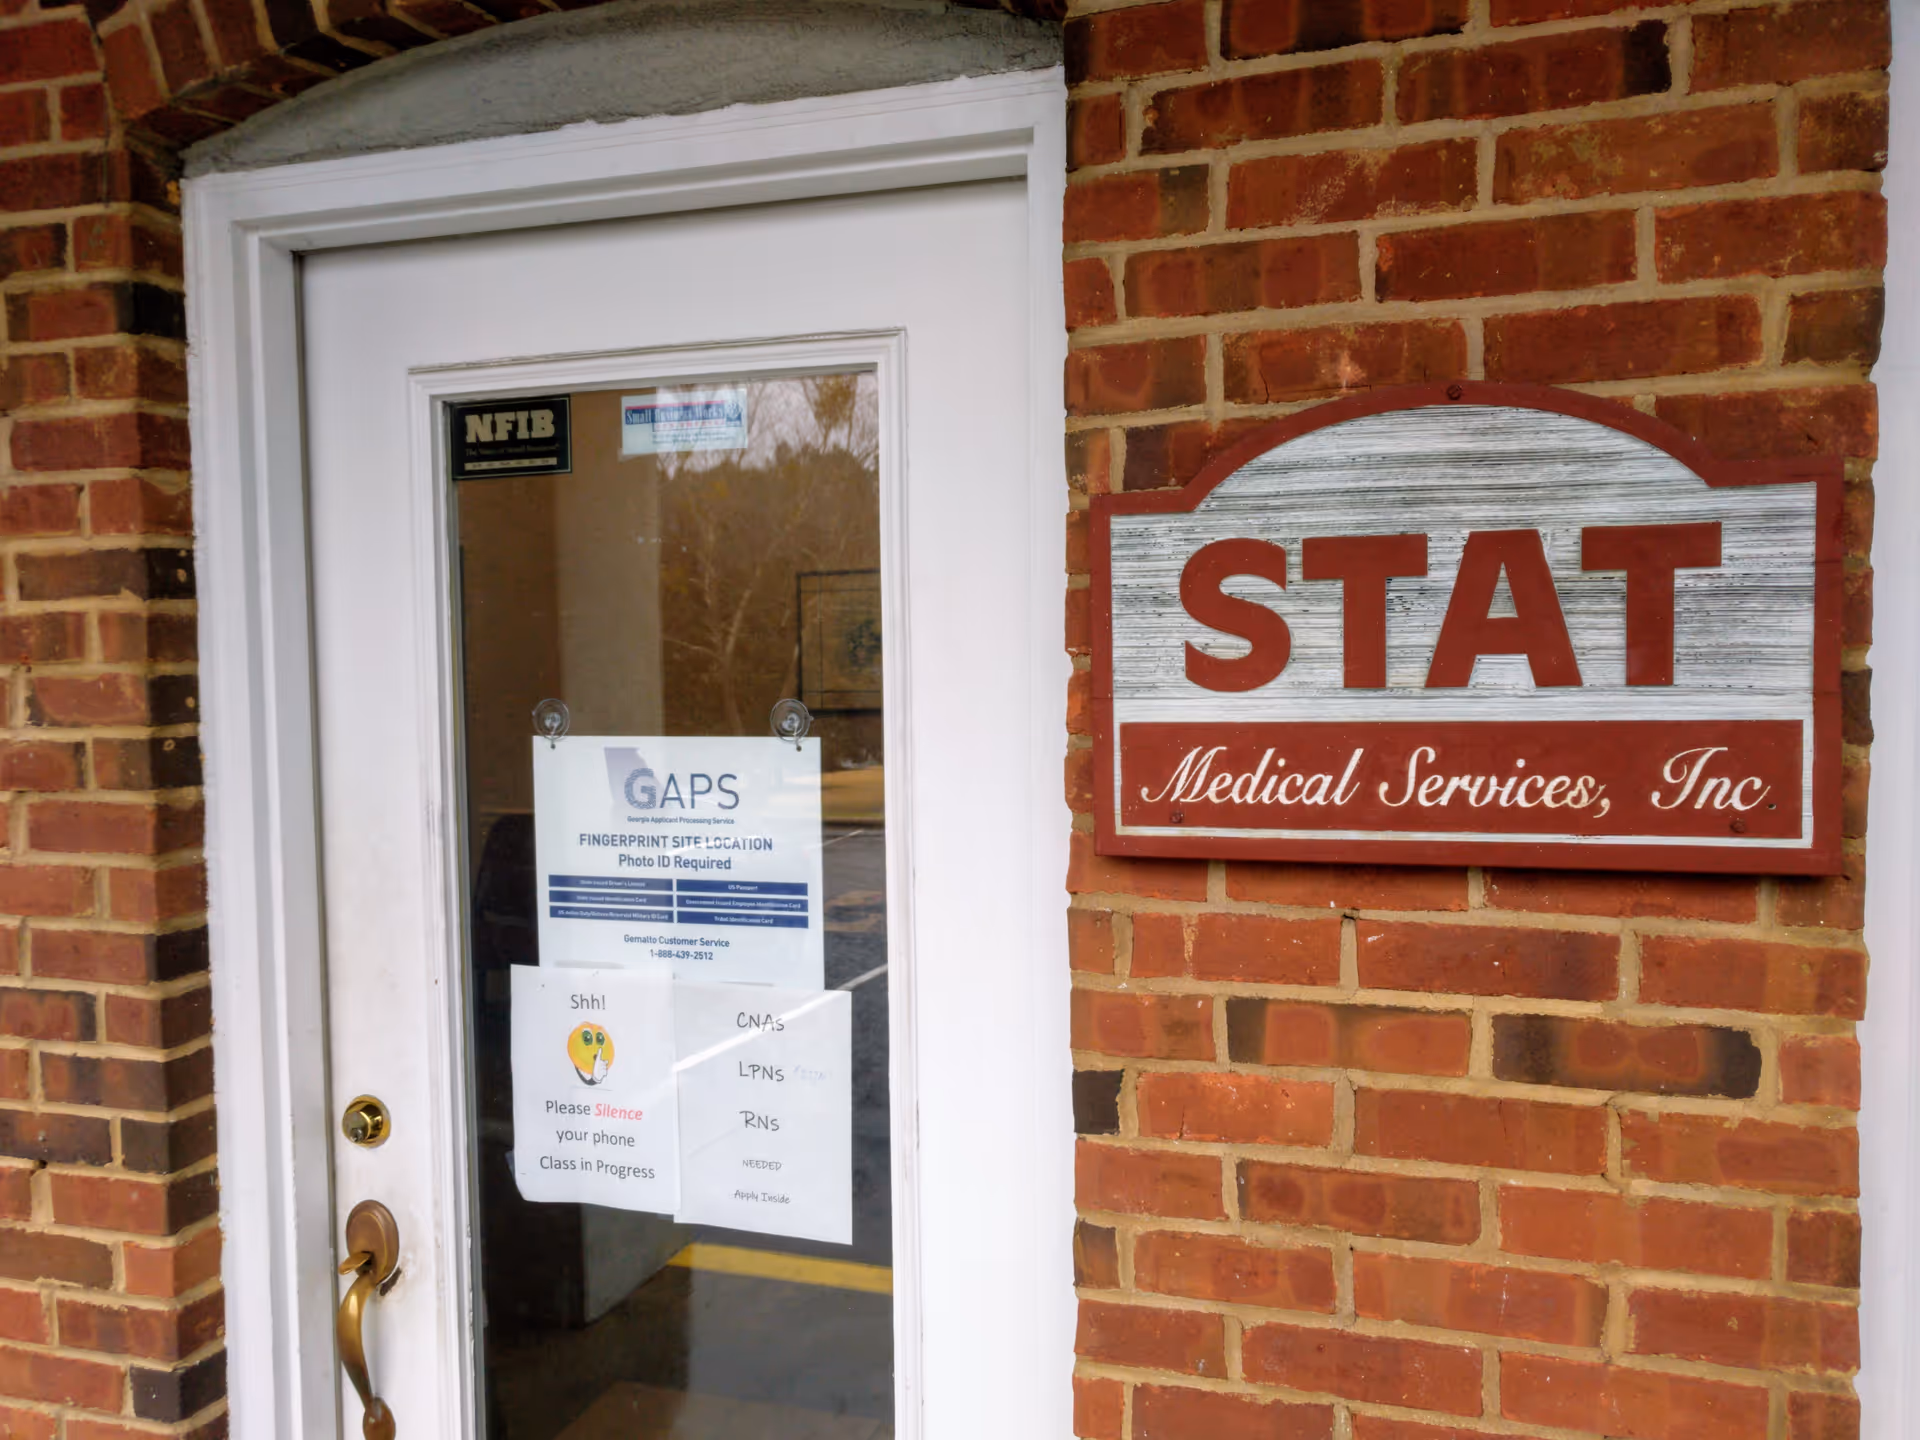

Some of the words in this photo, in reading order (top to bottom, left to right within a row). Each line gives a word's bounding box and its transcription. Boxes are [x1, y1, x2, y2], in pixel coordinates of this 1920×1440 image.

[464, 408, 555, 443] NFIB
[1179, 521, 1722, 692] STAT
[624, 767, 740, 810] GAPS
[1140, 746, 1364, 806] Medical
[1378, 746, 1610, 819] Services,
[627, 815, 650, 824] Georgia
[651, 816, 678, 824] Applicant
[679, 816, 712, 825] Processing
[712, 817, 735, 825] Service
[579, 833, 669, 848] FINGERPRINT
[672, 836, 701, 849] SITE
[705, 837, 773, 851] LOCATION
[619, 854, 654, 868] Photo
[658, 855, 670, 868] ID
[674, 855, 732, 871] Required
[623, 933, 657, 944] Gemalto
[658, 935, 699, 946] Customer
[699, 937, 731, 948] Service
[650, 949, 714, 960] 1-888-439-2512
[570, 993, 606, 1010] Shh!
[736, 1011, 785, 1032] CNAs
[739, 1060, 785, 1082] LPNs
[545, 1099, 591, 1116] Please
[593, 1102, 644, 1121] Silence
[739, 1110, 780, 1131] RNs
[556, 1129, 589, 1144] your
[592, 1129, 636, 1147] phone
[539, 1155, 577, 1171] Class
[580, 1157, 593, 1171] in
[596, 1159, 656, 1180] Progress
[742, 1159, 782, 1171] NEEDED
[733, 1189, 759, 1203] Apply
[760, 1192, 791, 1204] Inside
